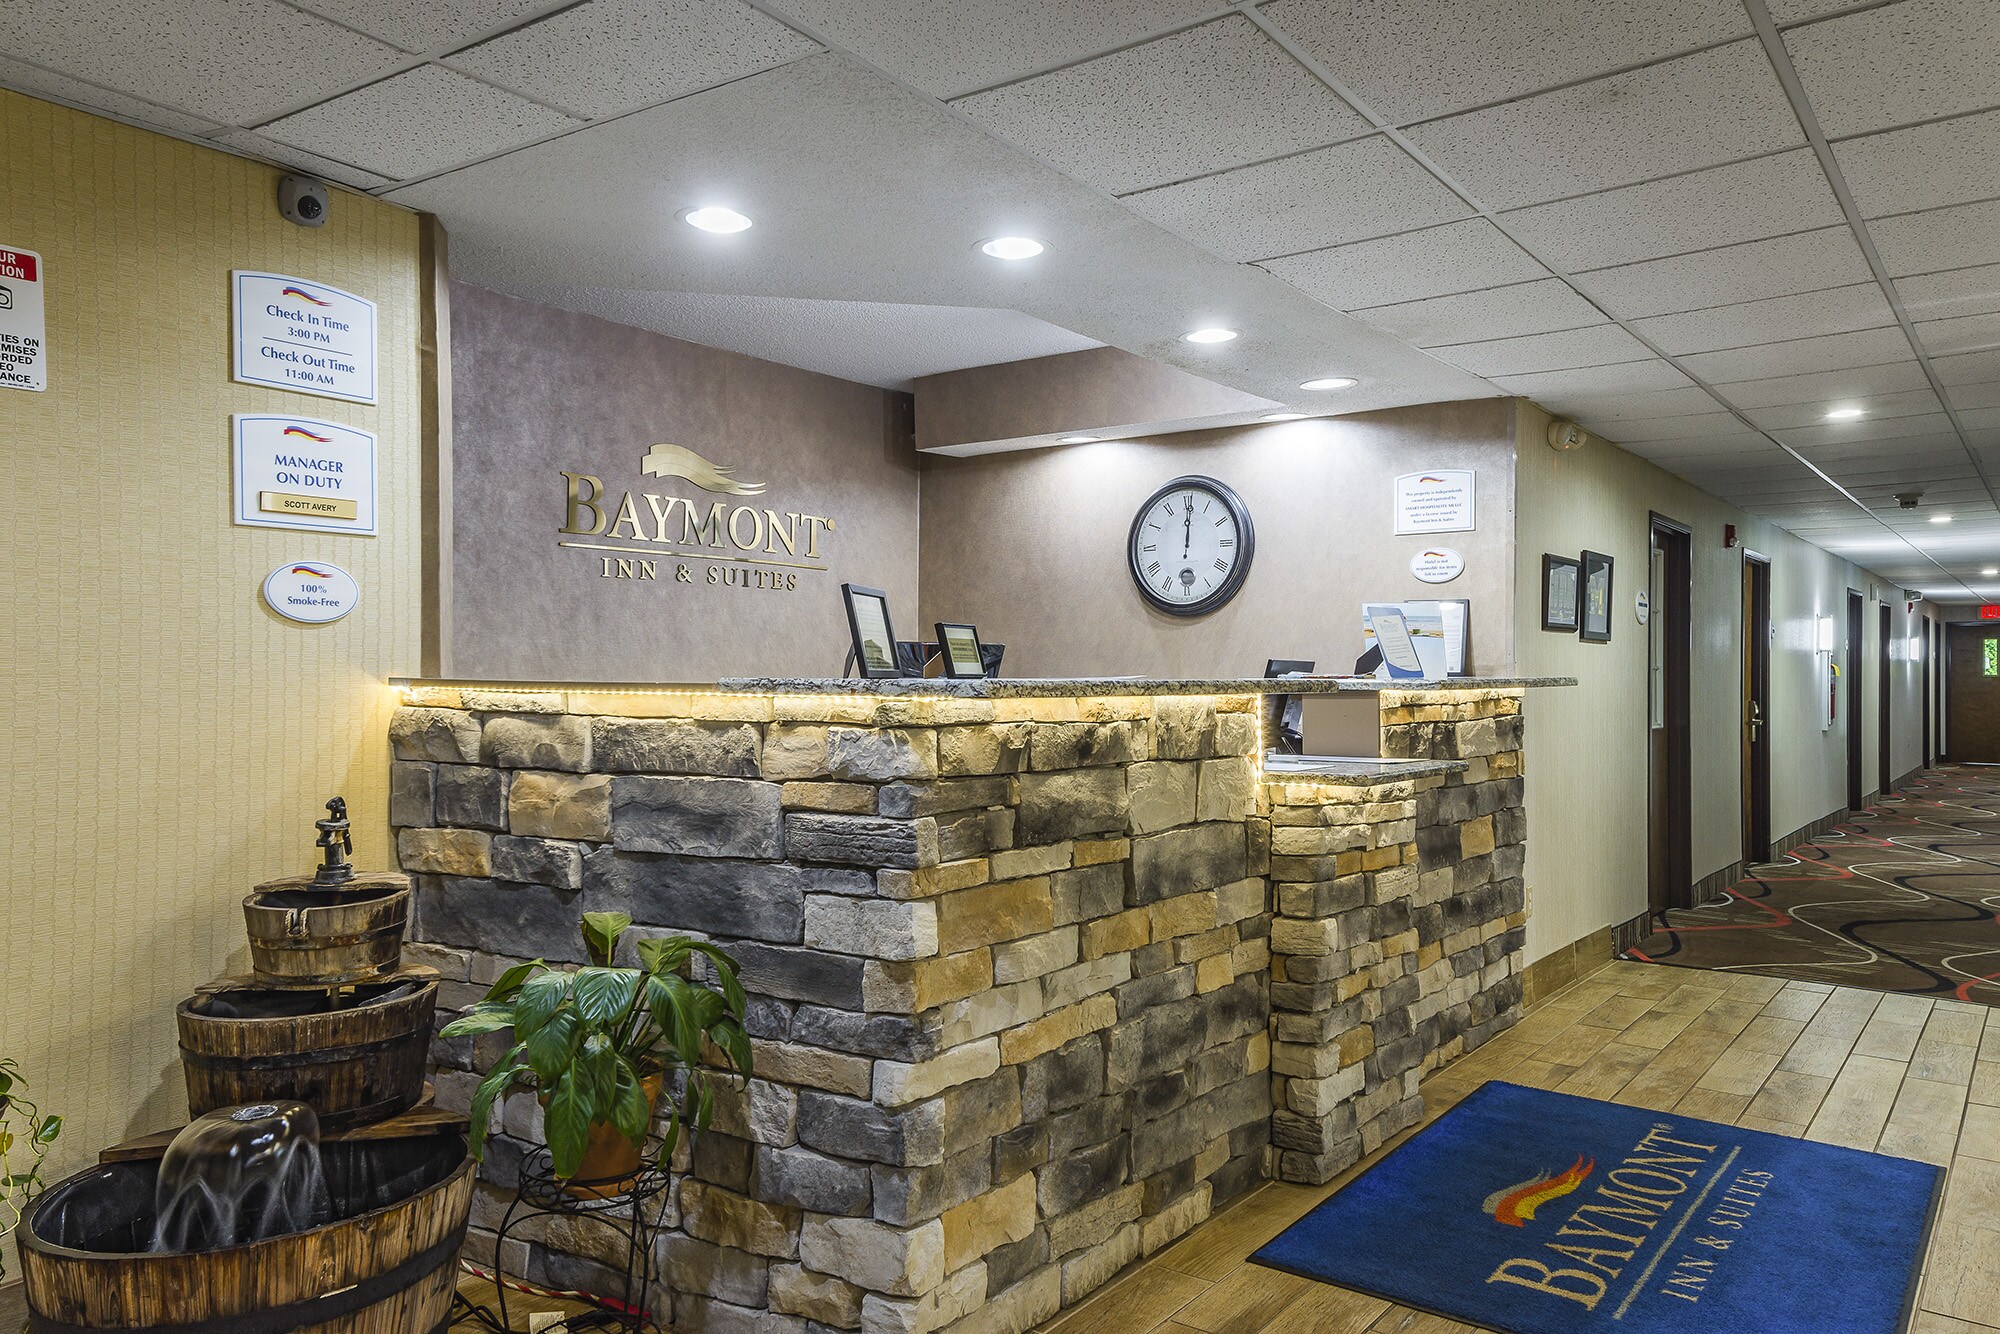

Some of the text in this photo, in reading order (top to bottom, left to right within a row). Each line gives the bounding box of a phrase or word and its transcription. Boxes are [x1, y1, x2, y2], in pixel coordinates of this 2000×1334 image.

[0, 264, 24, 278] ION
[266, 304, 350, 332] Check In Time
[0, 334, 39, 348] IES ON
[288, 327, 330, 343] 3:00 PM
[0, 353, 33, 365] RDED
[261, 346, 355, 373] Check Out Time
[285, 368, 334, 385] 11:00 AM
[274, 454, 344, 473] MANAGER
[276, 472, 342, 489] ON DUTY
[284, 500, 337, 512] SCOTT AVERY
[600, 556, 797, 592] INN & SUITES
[300, 584, 327, 594] 100%
[287, 596, 340, 607] Smoke-Free
[1660, 1168, 1775, 1303] INN & SUITES
